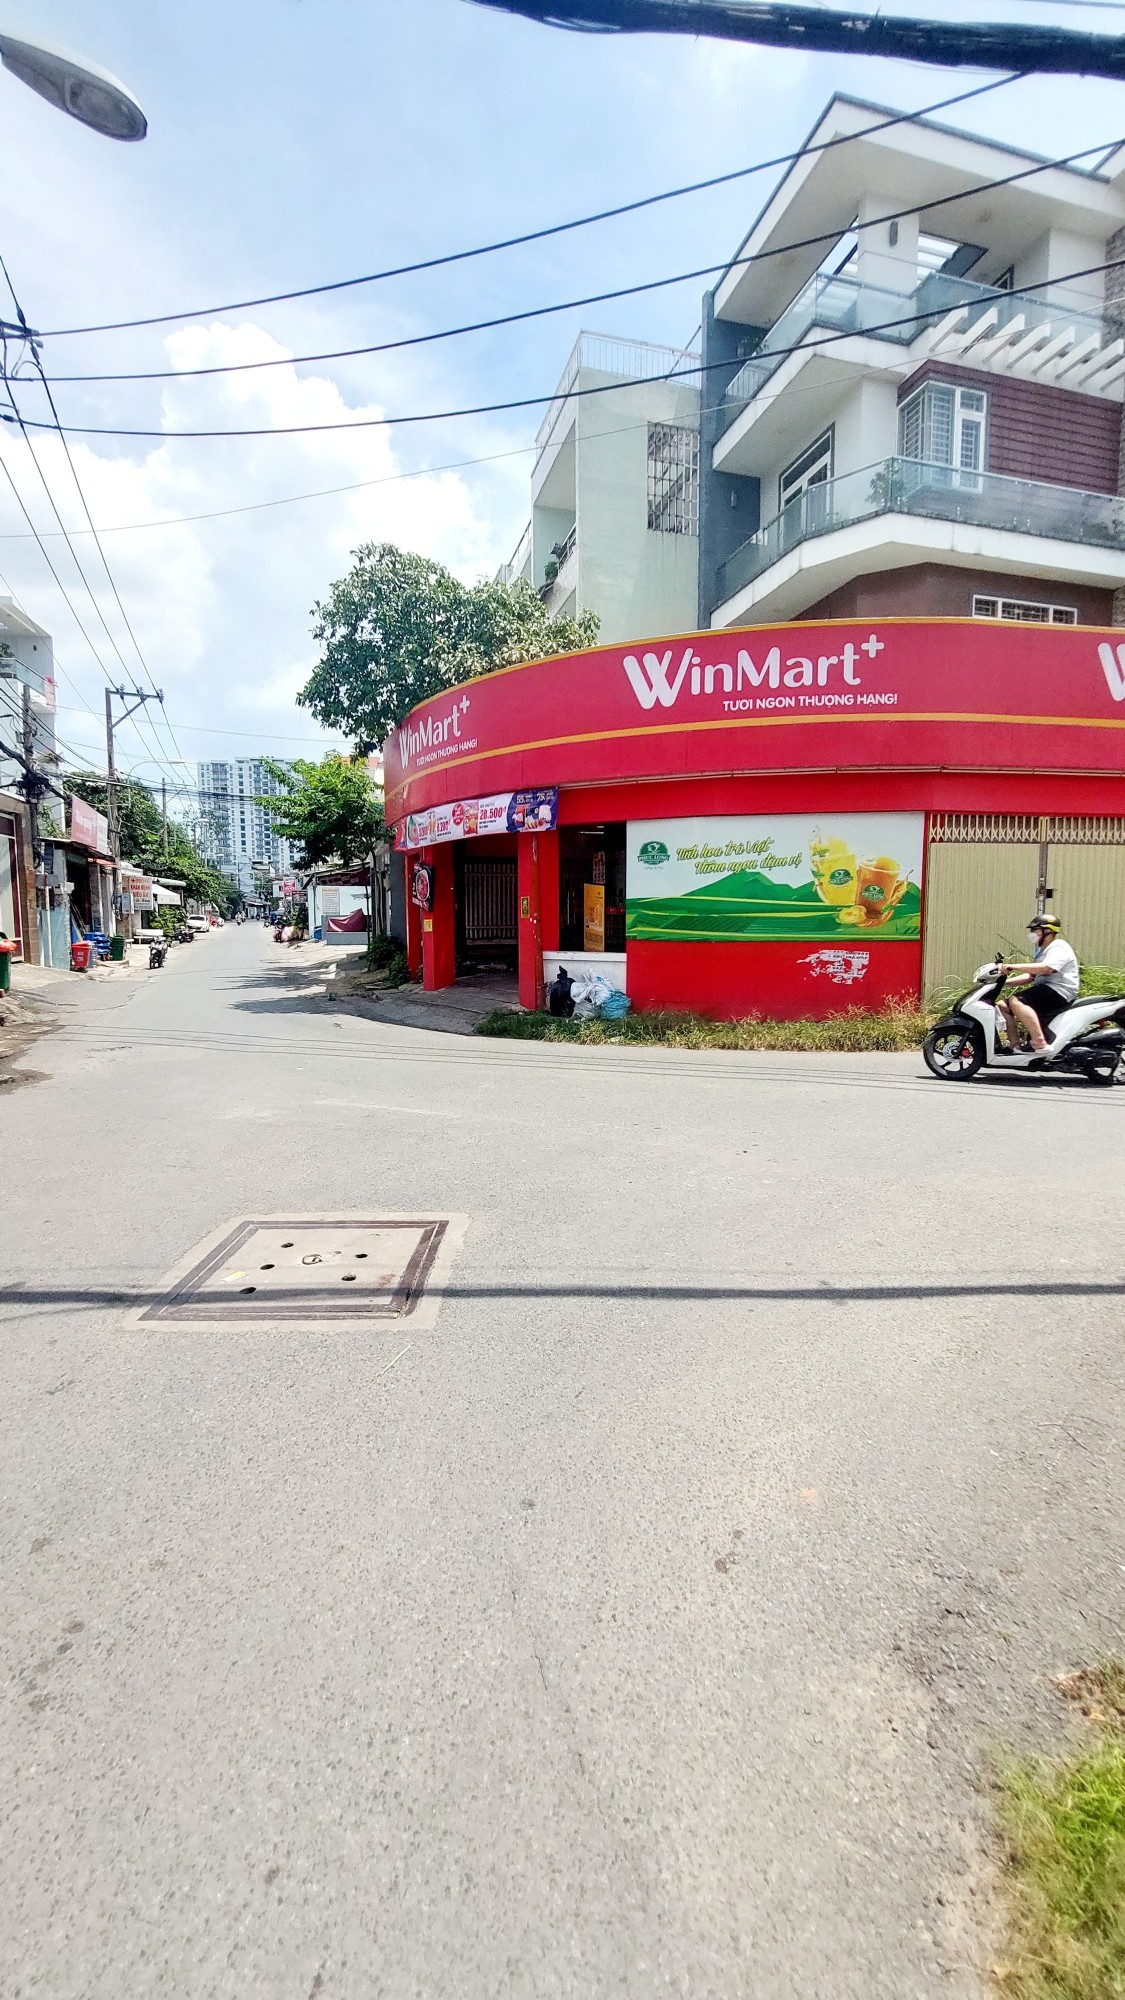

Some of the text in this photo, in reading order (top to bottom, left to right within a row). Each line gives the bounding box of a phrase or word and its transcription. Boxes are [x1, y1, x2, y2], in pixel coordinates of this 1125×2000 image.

[623, 634, 885, 709] WinMart+
[756, 696, 795, 709] NGON
[857, 692, 898, 707] HẠNG!
[399, 694, 471, 770] WinMart+
[699, 843, 723, 859] hoa
[744, 836, 774, 856] Việt
[727, 858, 758, 875] ngon
